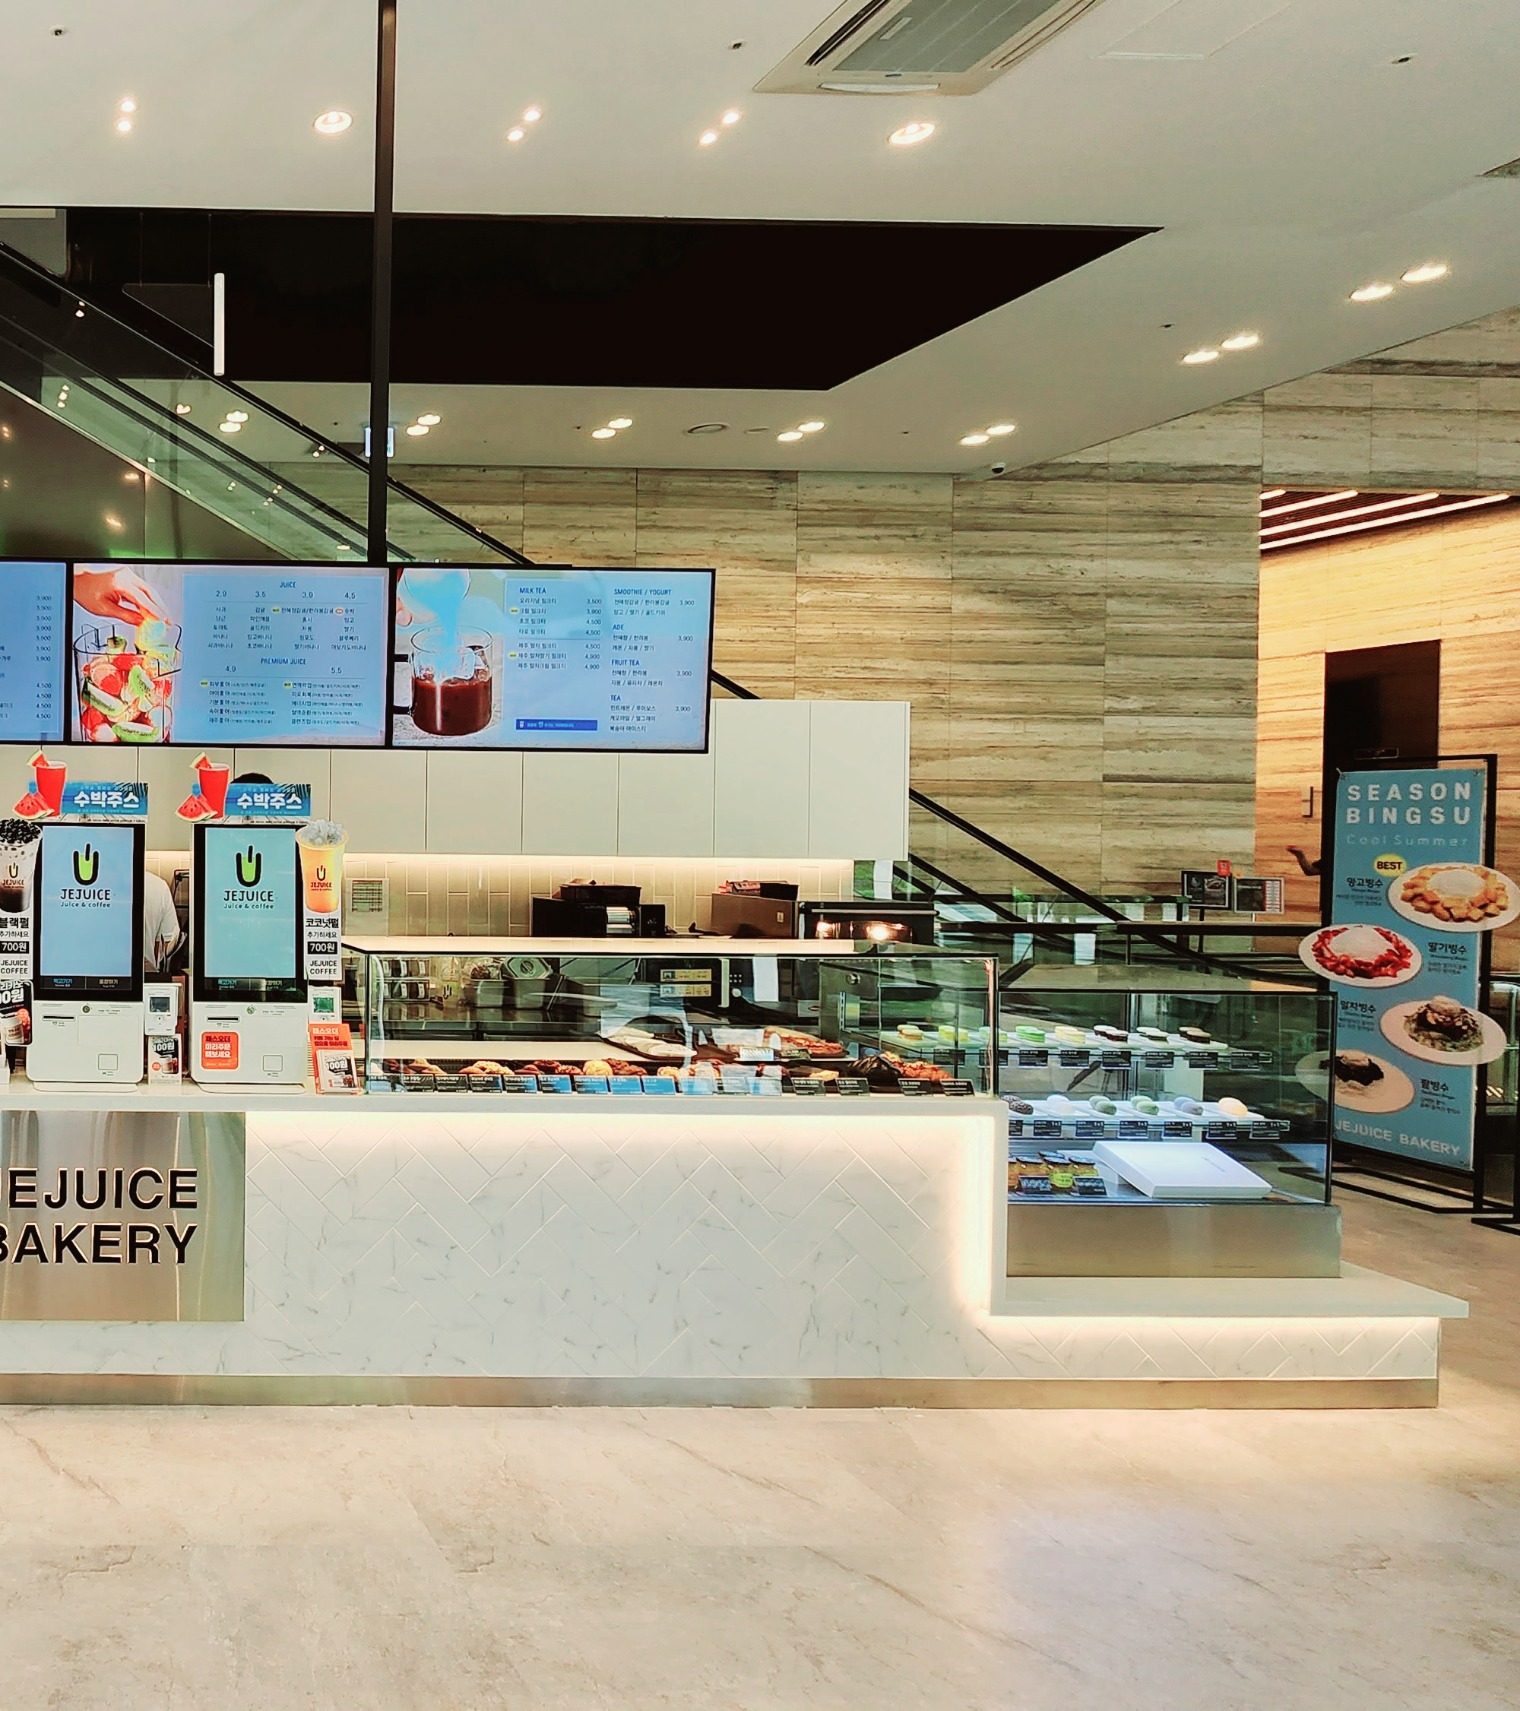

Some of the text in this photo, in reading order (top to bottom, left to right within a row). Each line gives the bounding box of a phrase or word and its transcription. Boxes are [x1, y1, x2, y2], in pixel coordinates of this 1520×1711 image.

[279, 581, 296, 589] JUICE
[1347, 782, 1472, 801] SEASON
[74, 791, 140, 808] 수박주스
[236, 793, 302, 810] 수박주스
[1346, 806, 1471, 825] BINGSU
[1346, 833, 1469, 847] Cool Summer
[1376, 861, 1403, 870] BEST
[1347, 877, 1384, 888] 망고빙수
[60, 889, 111, 900] JEJUICE
[223, 890, 274, 902] JEJUICE
[305, 918, 339, 929] 코코넛펄
[307, 931, 337, 939] 추가하세요
[1, 942, 27, 953] 700원
[309, 943, 335, 953] 700원
[1428, 941, 1467, 955] 딸기빙수
[0, 967, 28, 975] COFFEE
[312, 1027, 339, 1035] 패스오더
[205, 1043, 231, 1051] 미리주문
[205, 1050, 231, 1058] 해보세요
[1335, 1120, 1461, 1156] JEJUICE BAKERY
